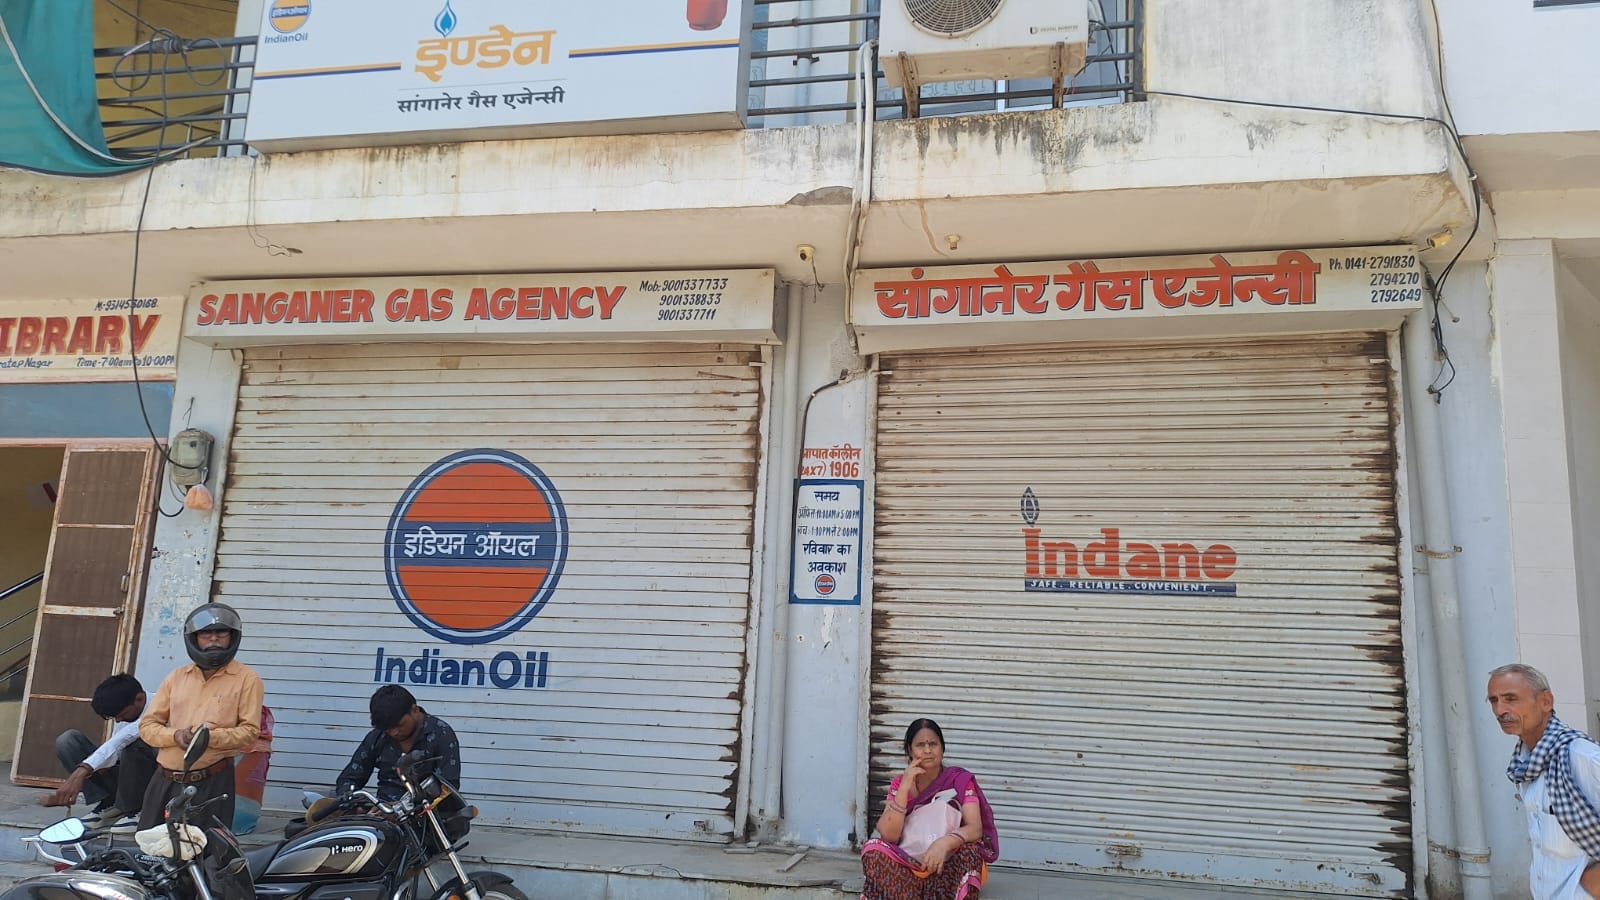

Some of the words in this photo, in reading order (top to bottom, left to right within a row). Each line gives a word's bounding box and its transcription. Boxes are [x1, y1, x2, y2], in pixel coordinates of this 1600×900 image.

[264, 32, 309, 44] IndianOil
[415, 24, 557, 83] इण्डेन
[398, 92, 462, 113] सांगानेर
[468, 90, 498, 108] गैस
[502, 86, 565, 109] एजेन्सी
[1329, 257, 1342, 270] Ph.
[1345, 255, 1415, 270] 0141-2791830
[873, 267, 1050, 319] सांगानेर
[1053, 260, 1150, 312] गैस
[1149, 250, 1321, 308] एजेन्सी
[1370, 271, 1420, 286] 2794270
[659, 293, 721, 306] 9001338833
[1371, 288, 1422, 303] 2792649
[197, 289, 375, 325] SANGANER
[385, 288, 453, 322] GAS
[464, 285, 627, 320] AGENCY
[657, 308, 716, 321] 9001337711
[829, 461, 860, 478] 1906
[813, 491, 840, 501] समय
[474, 532, 540, 557] ऑयल
[803, 540, 834, 555] रविवार
[837, 544, 852, 556] का
[1022, 528, 1237, 579] Indane
[808, 562, 847, 575] अवकाश
[374, 647, 549, 689] IndianOil
